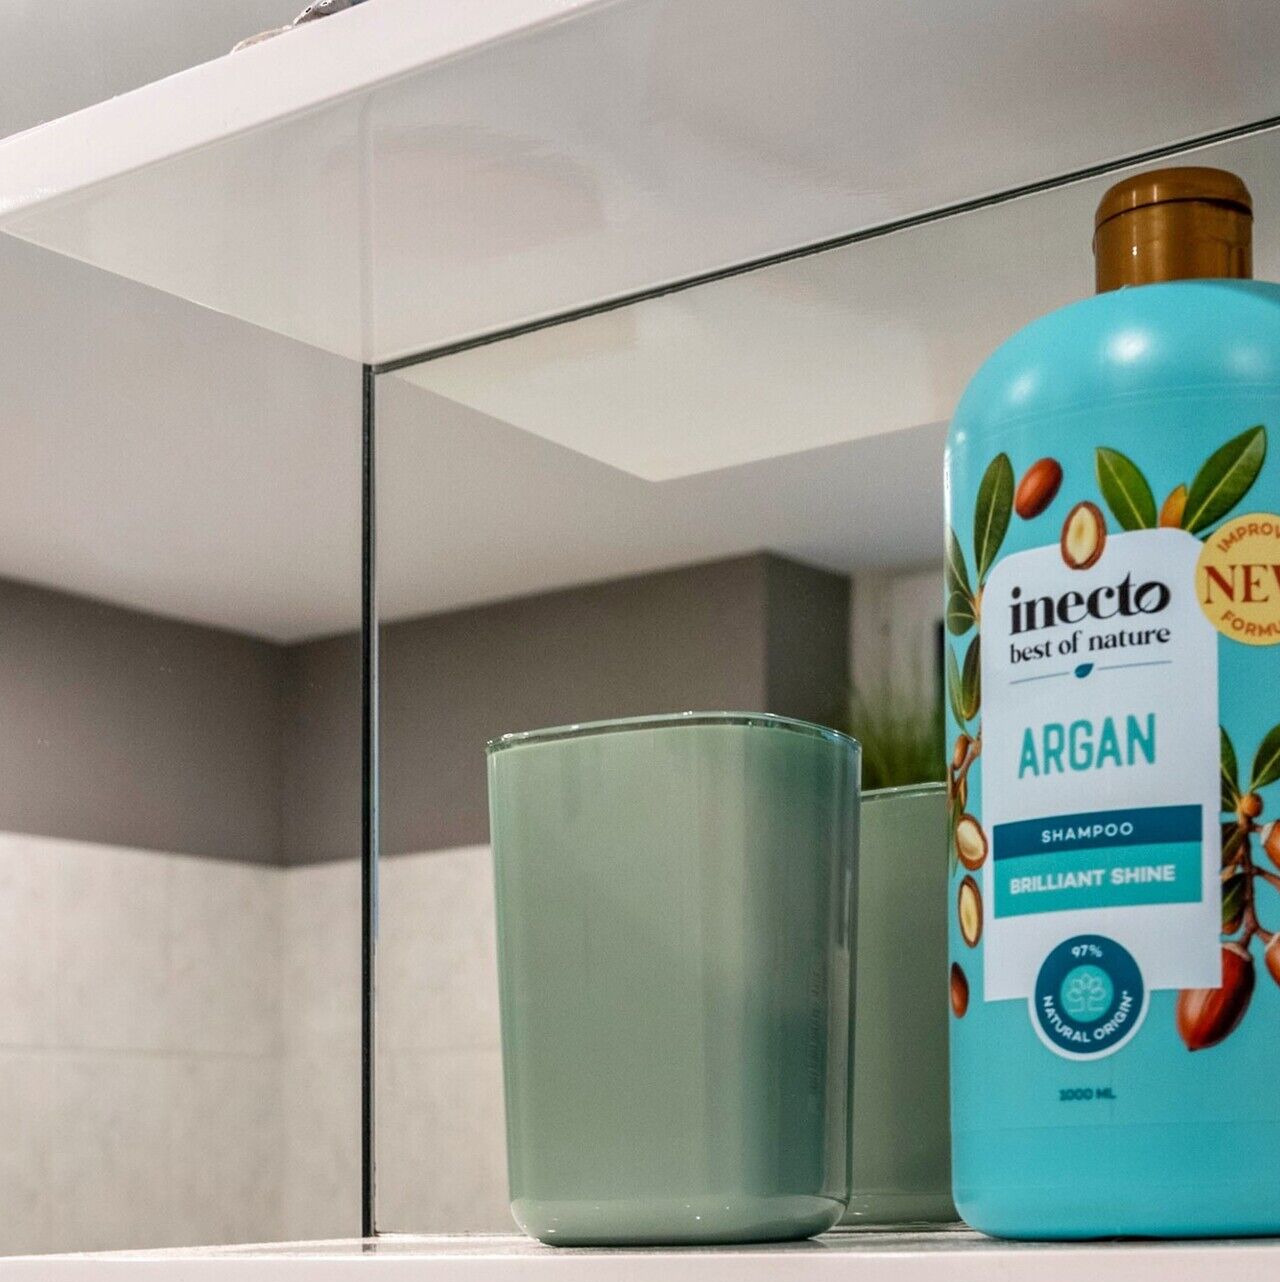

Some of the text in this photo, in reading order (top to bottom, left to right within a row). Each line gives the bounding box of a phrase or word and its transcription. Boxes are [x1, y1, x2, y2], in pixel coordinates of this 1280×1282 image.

[1009, 571, 1171, 636] inecto
[1010, 628, 1171, 664] best of nature
[1018, 713, 1156, 779] ARGAN
[1041, 822, 1134, 843] SHAMPOO
[1010, 864, 1176, 895] BRILLIANT SHINE
[1071, 944, 1103, 958] 97%
[1043, 995, 1091, 1043] NATURAL
